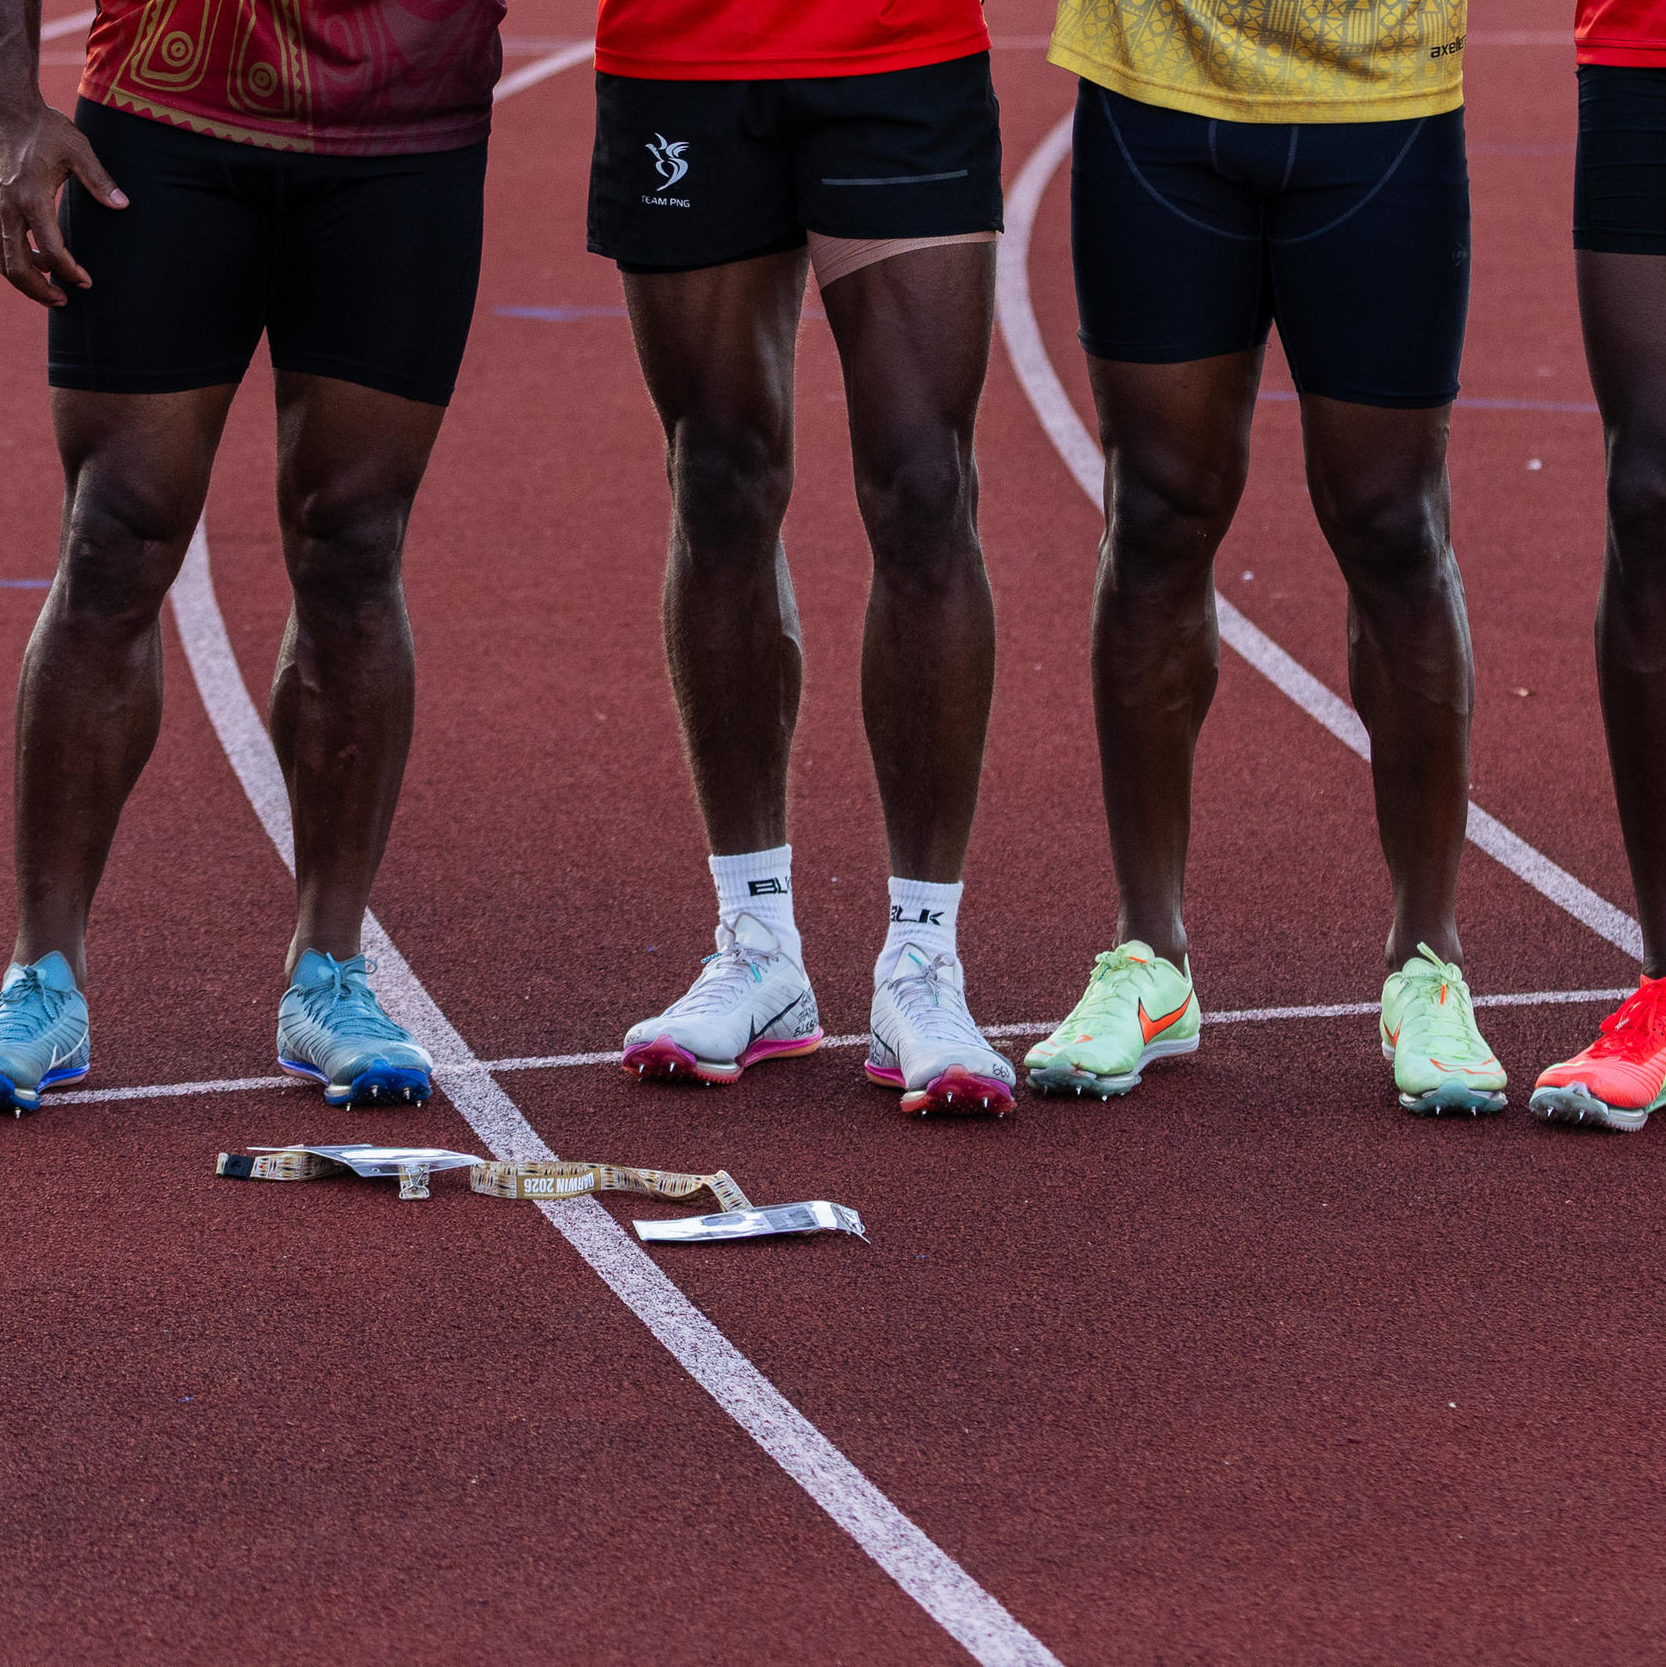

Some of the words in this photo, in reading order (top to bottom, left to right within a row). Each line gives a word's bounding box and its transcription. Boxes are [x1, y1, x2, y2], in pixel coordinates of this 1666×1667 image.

[641, 195, 667, 206] TEAM
[669, 198, 691, 208] PNG
[524, 1178, 555, 1193] 2026
[556, 1172, 595, 1193] DARWIN
